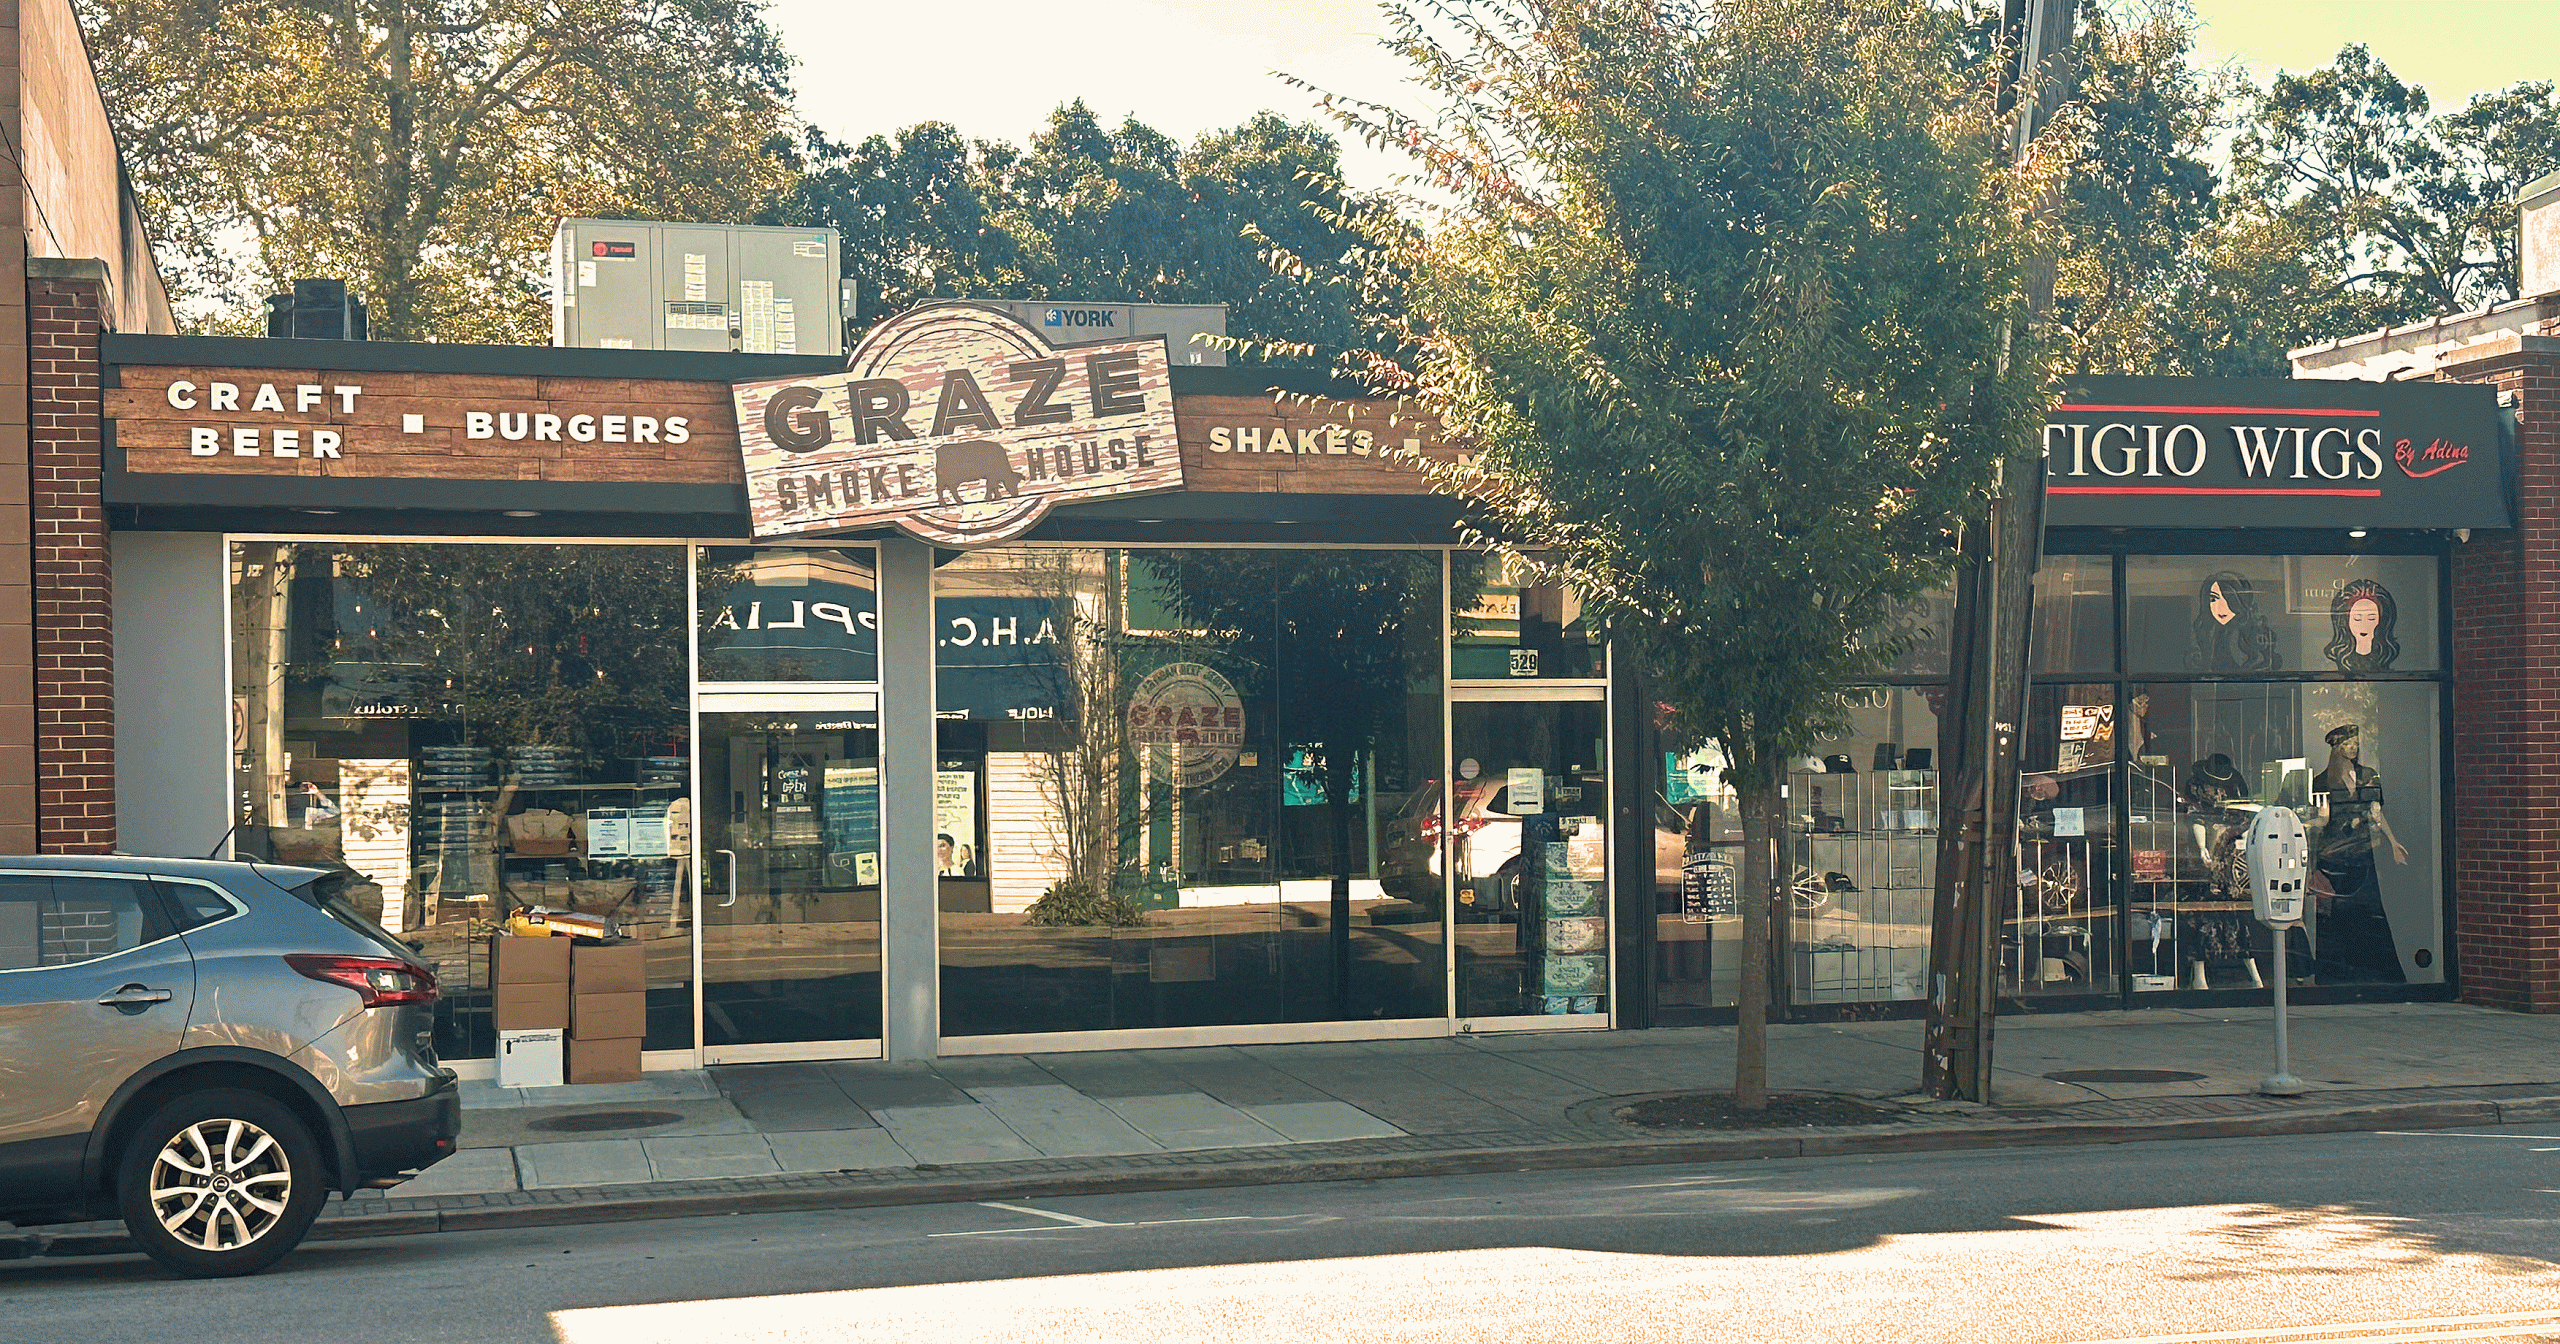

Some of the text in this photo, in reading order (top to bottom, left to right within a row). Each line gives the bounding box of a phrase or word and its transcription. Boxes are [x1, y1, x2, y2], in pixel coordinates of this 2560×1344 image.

[1062, 310, 1115, 327] YORK
[167, 379, 363, 414] CRAFT
[764, 350, 1147, 453] GRAZE
[190, 427, 344, 460] BEER
[465, 410, 691, 446] BURGERS
[1208, 426, 1375, 456] SHAKES
[2230, 425, 2383, 481] WIGS
[2395, 437, 2469, 467] By Adina
[776, 434, 1156, 512] SMOKE HOUSE
[1511, 654, 1538, 671] 529
[1129, 704, 1242, 728] GRAZE
